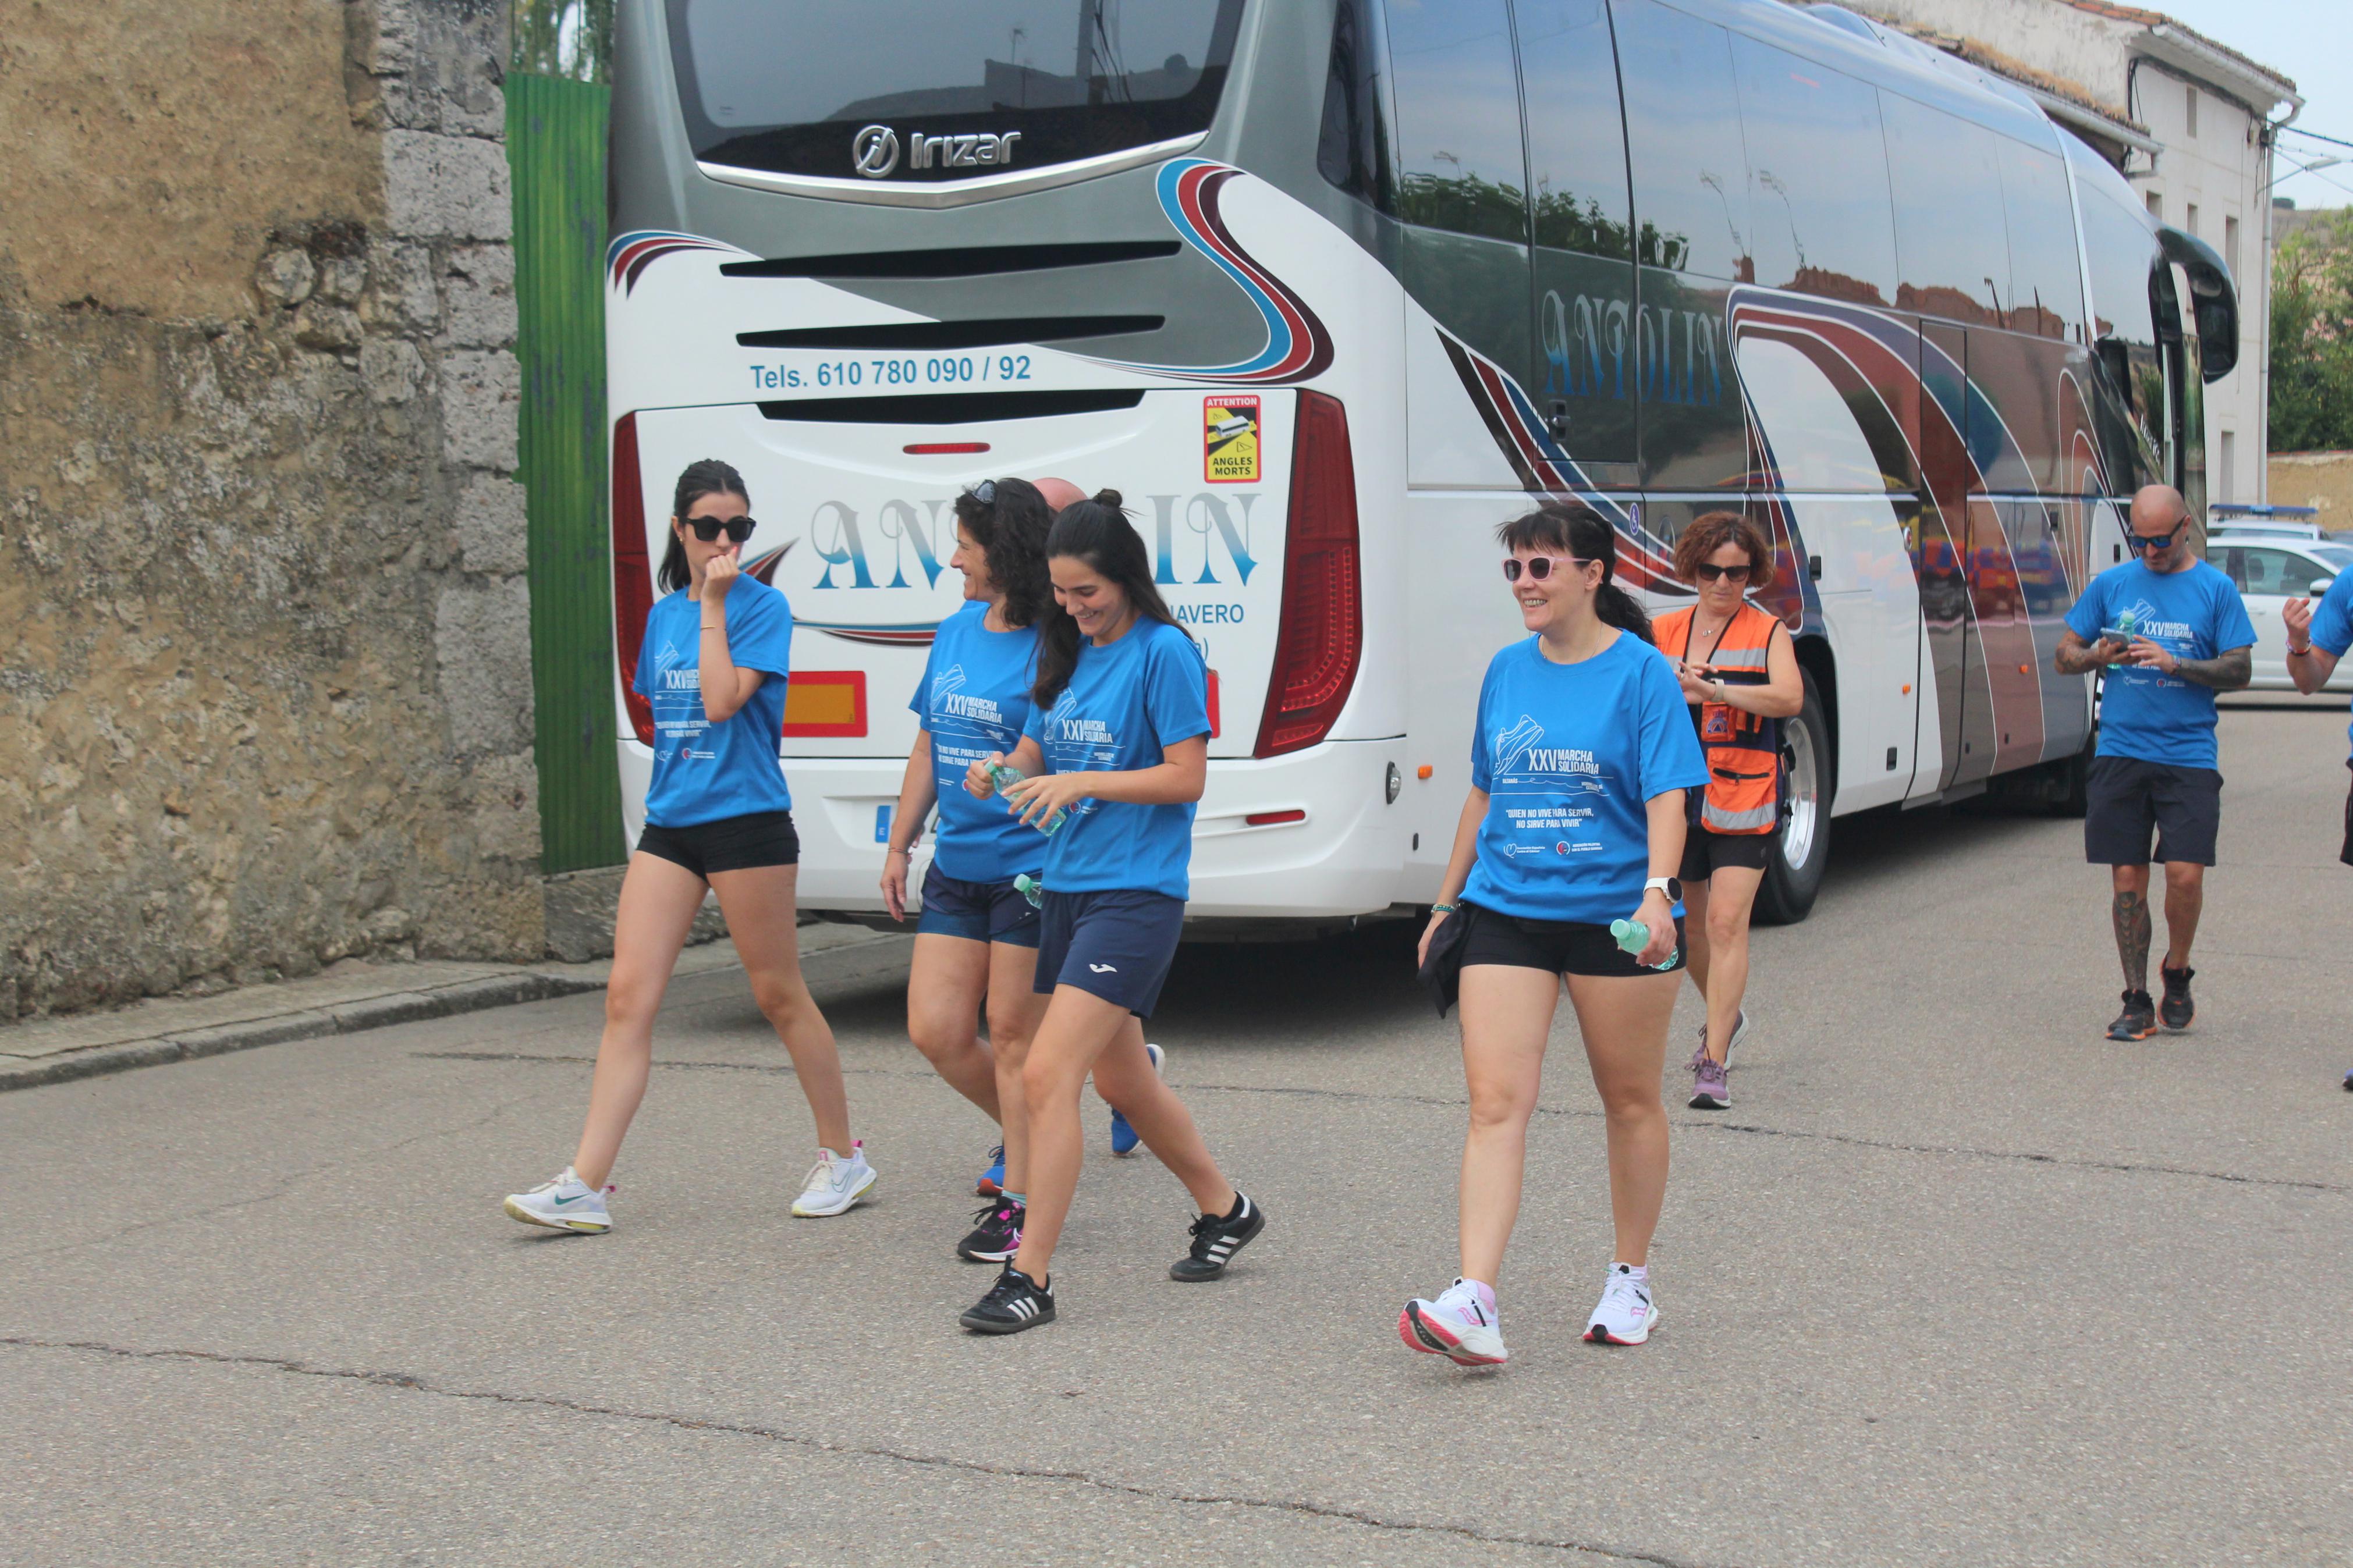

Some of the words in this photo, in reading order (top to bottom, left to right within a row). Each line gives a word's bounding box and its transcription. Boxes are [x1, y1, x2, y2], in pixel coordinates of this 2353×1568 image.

[751, 365, 808, 389] Tels.
[818, 362, 863, 387] 610
[872, 359, 917, 385] 780
[927, 357, 974, 382] 090
[982, 356, 989, 381] /
[999, 355, 1032, 381] 92
[1206, 397, 1258, 407] ATTENTION
[1213, 457, 1253, 466] ANGLES
[1215, 467, 1251, 476] MORTS
[2142, 620, 2164, 637] XXV
[2164, 621, 2189, 632] MARCHA
[2163, 629, 2193, 639] SOLIDARIA
[945, 692, 968, 716] XXV
[967, 696, 998, 713] MARCHA
[967, 706, 1002, 724] SOLIDARIA
[1528, 749, 1557, 771] XXV
[1557, 749, 1593, 763] MARCHA
[1558, 760, 1599, 774] SOLIDARIA
[1528, 809, 1538, 818] NO
[1538, 808, 1552, 817] VIVE
[1516, 819, 1526, 829] NO
[1527, 819, 1545, 829] SIRVE
[1546, 819, 1561, 828] PARA
[879, 827, 886, 835] E
